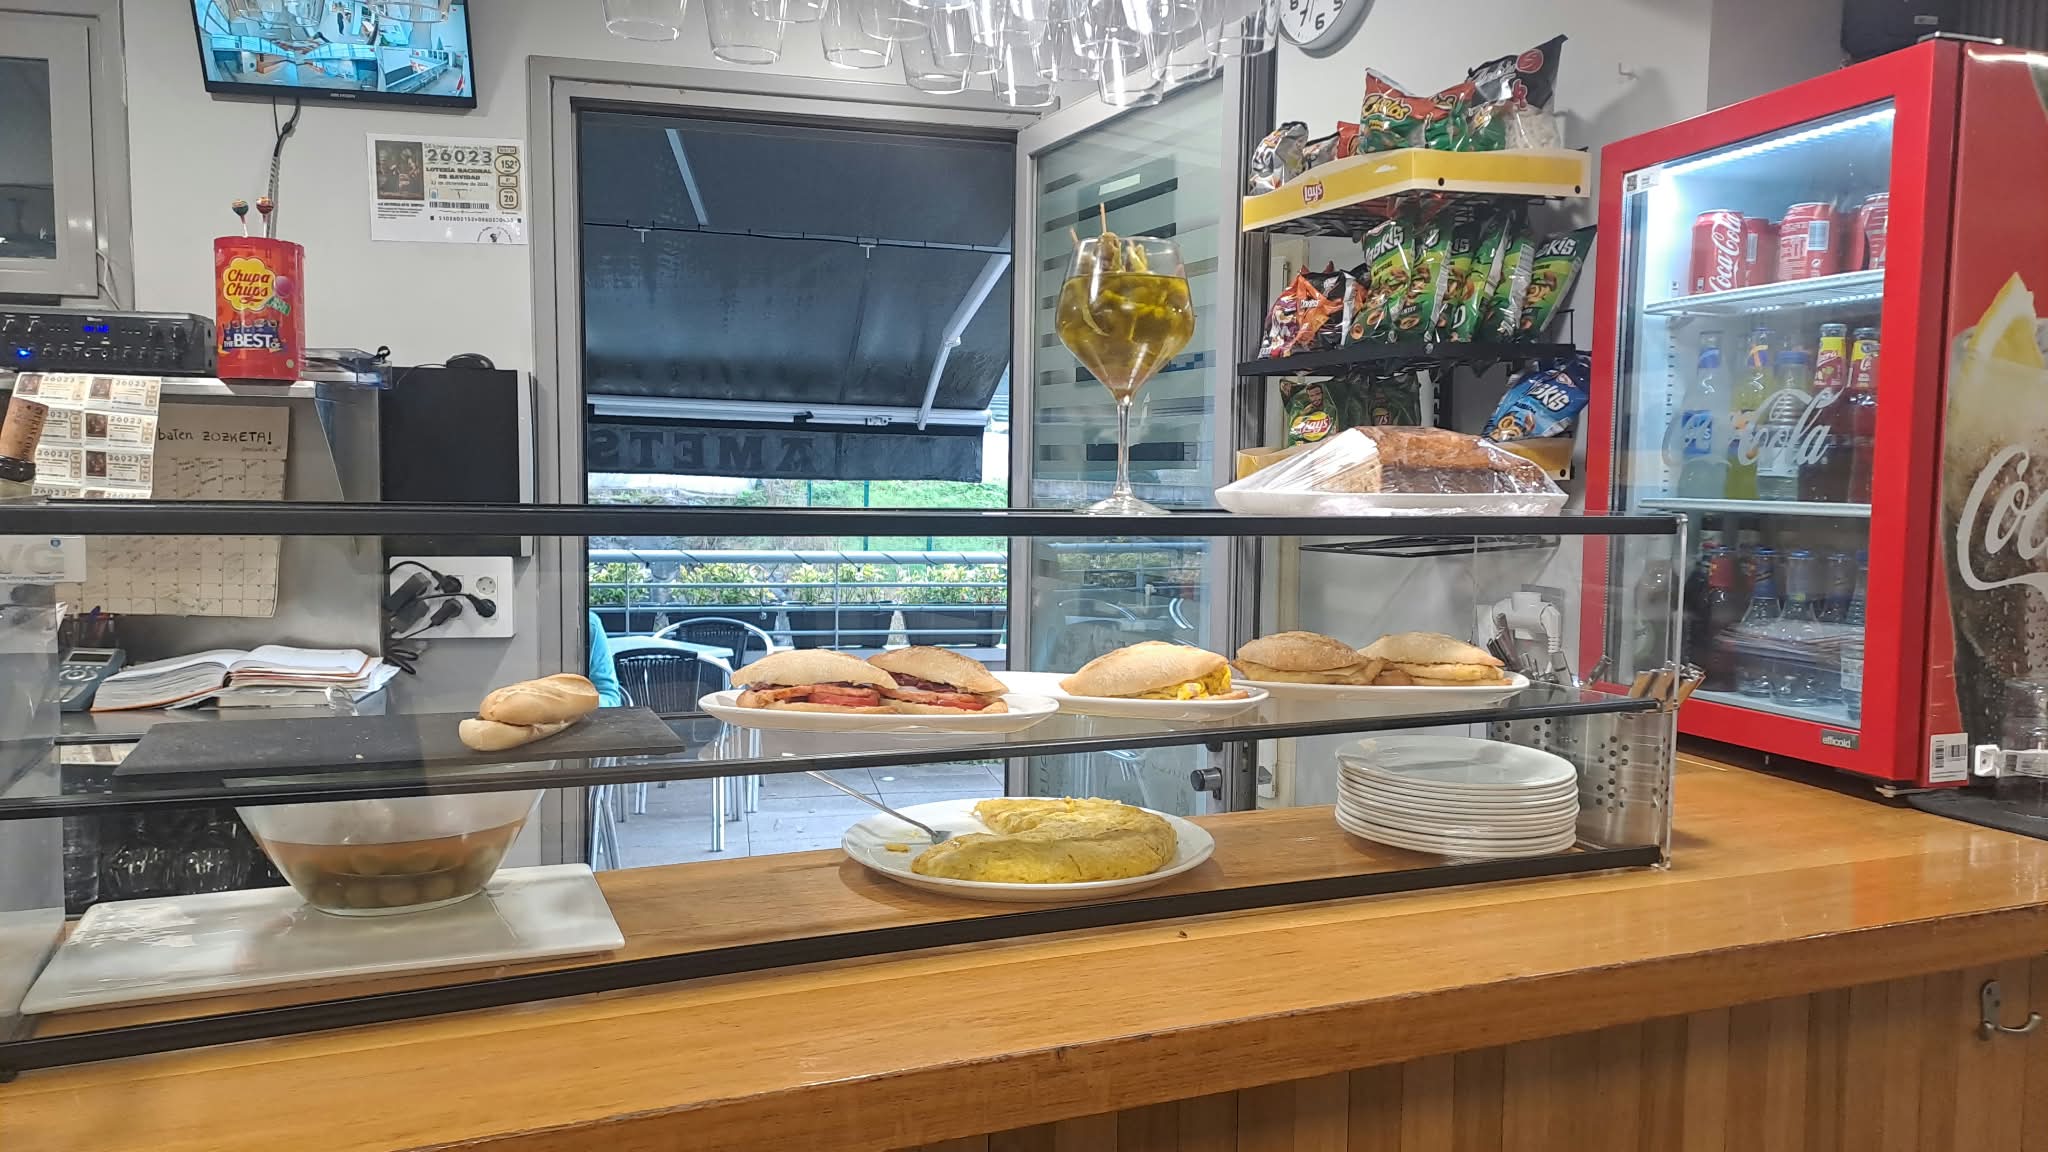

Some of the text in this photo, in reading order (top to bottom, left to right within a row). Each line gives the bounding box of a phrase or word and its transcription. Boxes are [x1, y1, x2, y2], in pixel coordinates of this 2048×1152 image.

[1314, 12, 1326, 31] 6
[427, 148, 492, 164] 26023
[503, 195, 514, 204] 20
[227, 268, 271, 286] Chupa
[226, 282, 269, 297] Chups
[233, 333, 273, 349] BEST
[50, 411, 70, 419] 023
[110, 416, 143, 425] 26023
[37, 449, 70, 459] 26023
[108, 454, 140, 464] 26023
